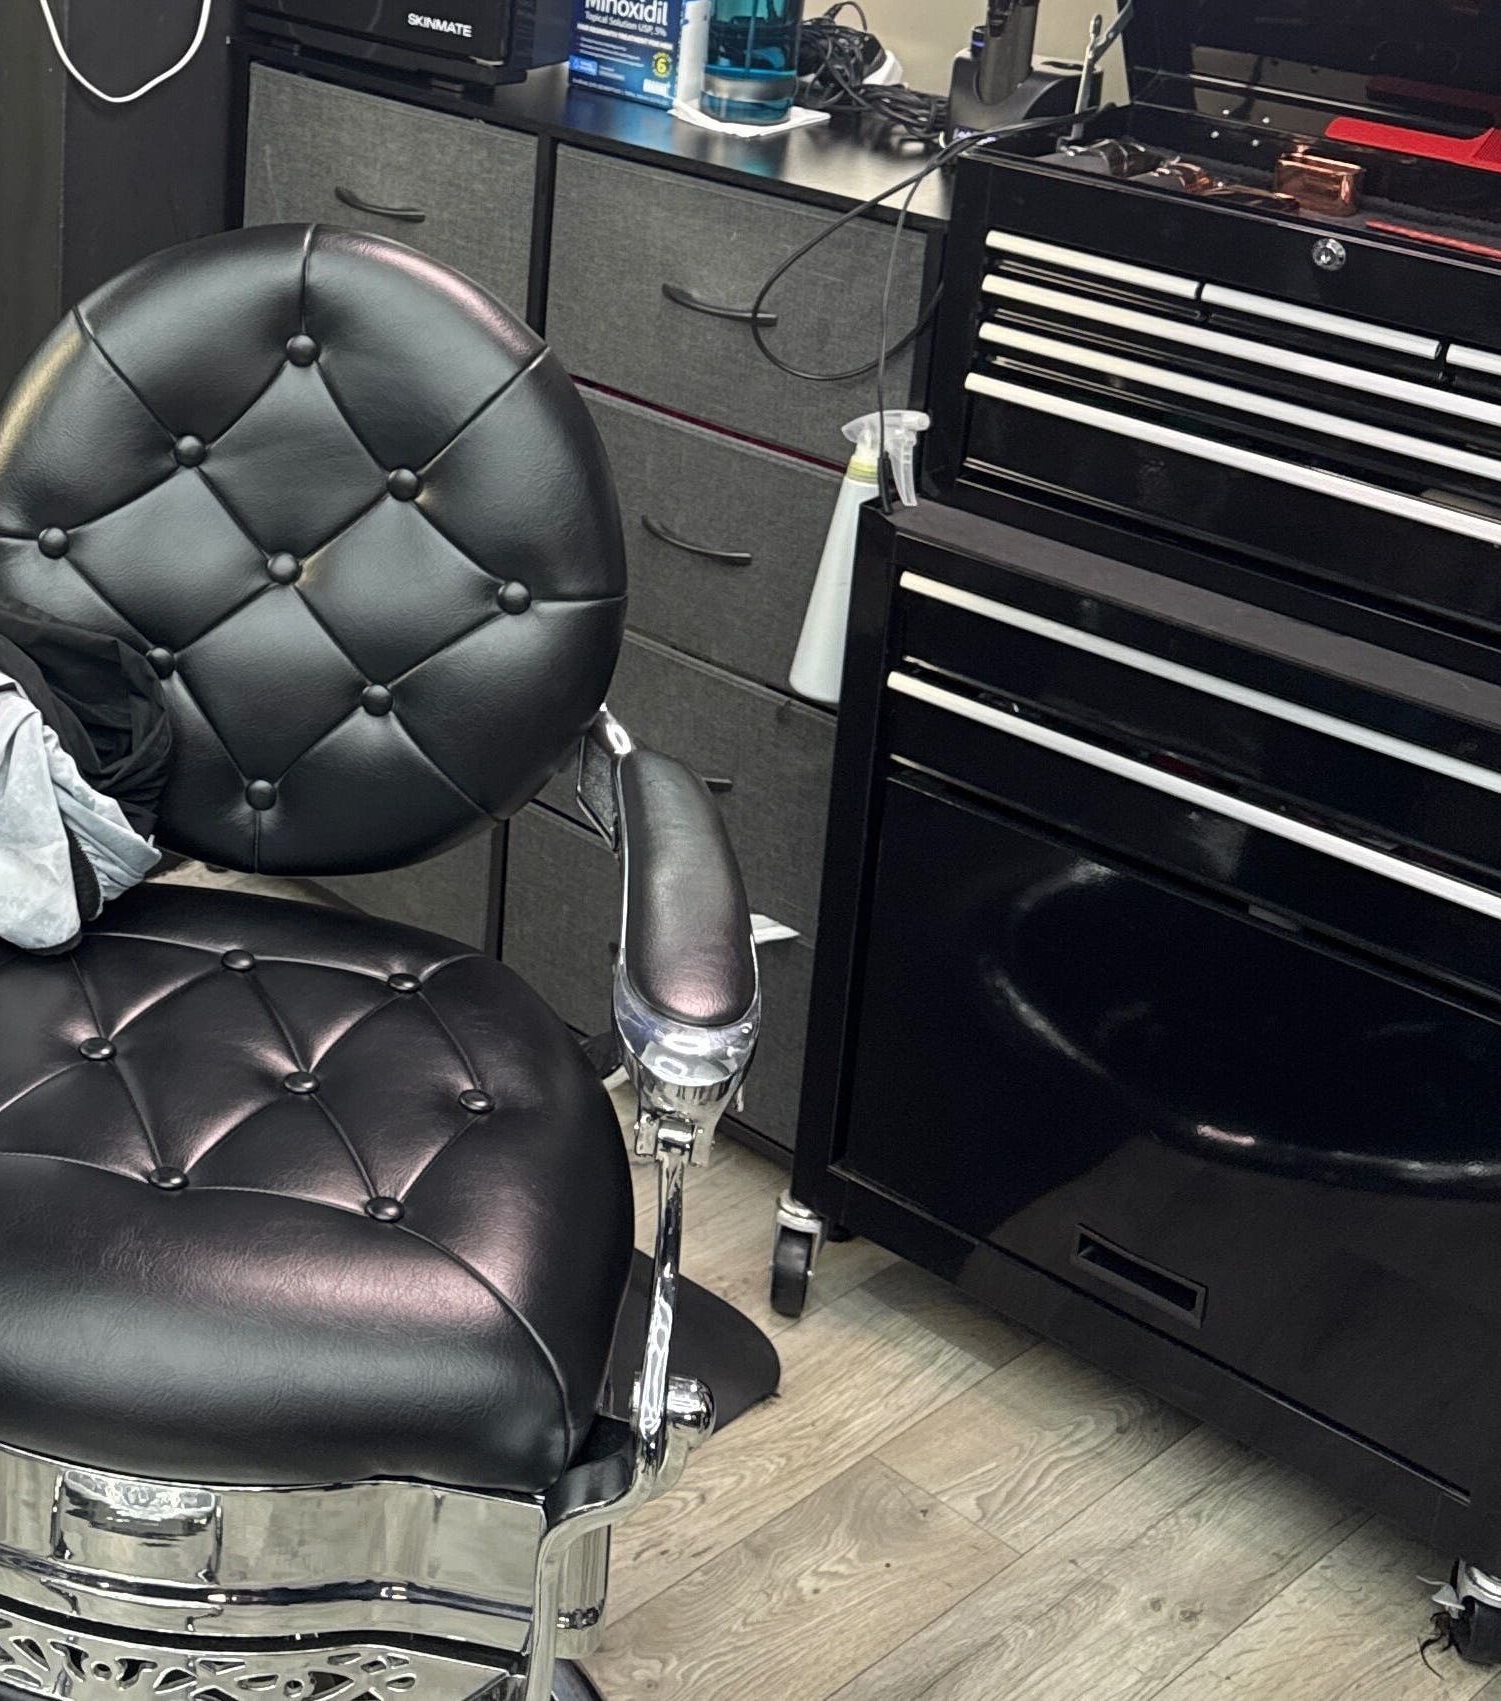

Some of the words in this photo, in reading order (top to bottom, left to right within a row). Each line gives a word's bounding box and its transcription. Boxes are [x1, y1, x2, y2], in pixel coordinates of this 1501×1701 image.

[407, 12, 473, 38] SKINMATE
[609, 16, 637, 30] Solution
[656, 57, 667, 74] 6
